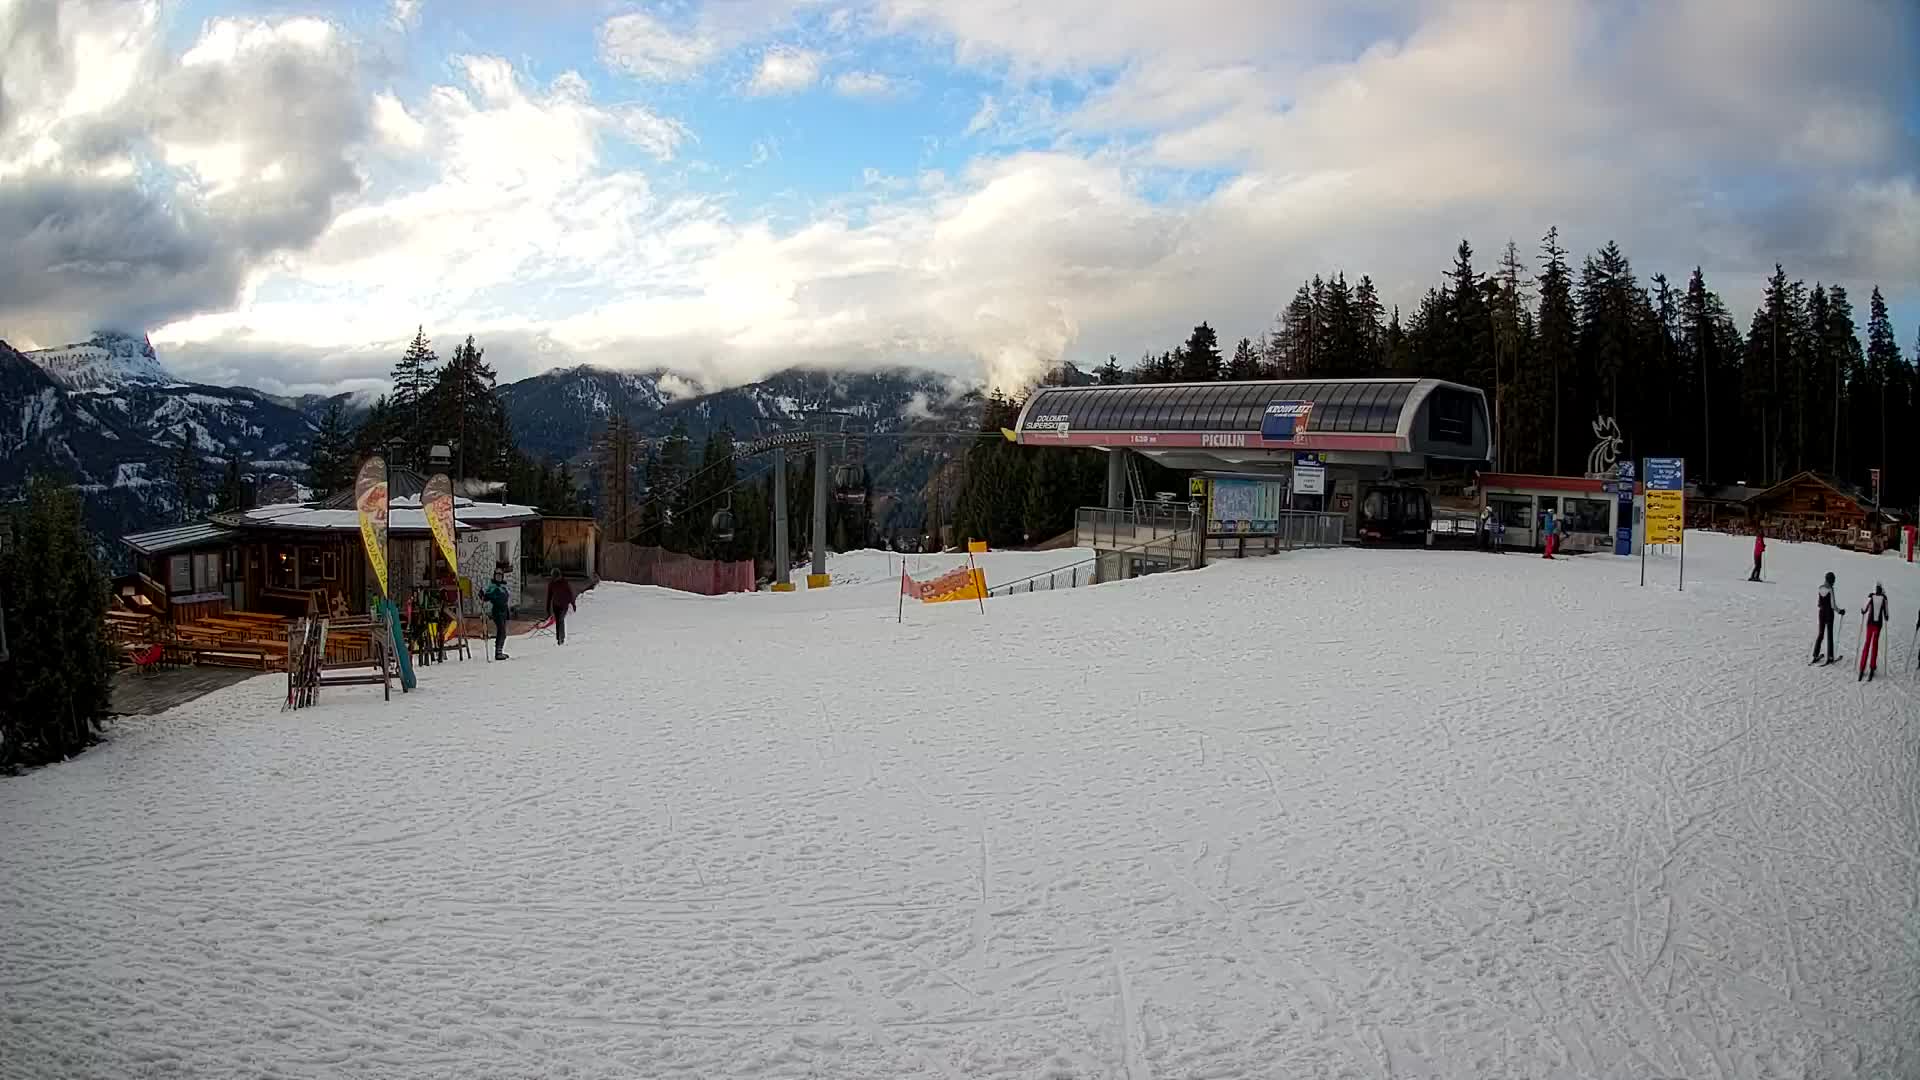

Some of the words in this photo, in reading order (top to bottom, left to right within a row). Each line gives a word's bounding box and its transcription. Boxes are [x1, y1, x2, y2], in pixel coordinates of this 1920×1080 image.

[1266, 405, 1312, 414] KRONPLATZ
[1025, 422, 1059, 430] SUPERSKI
[1201, 434, 1245, 447] PICULIN
